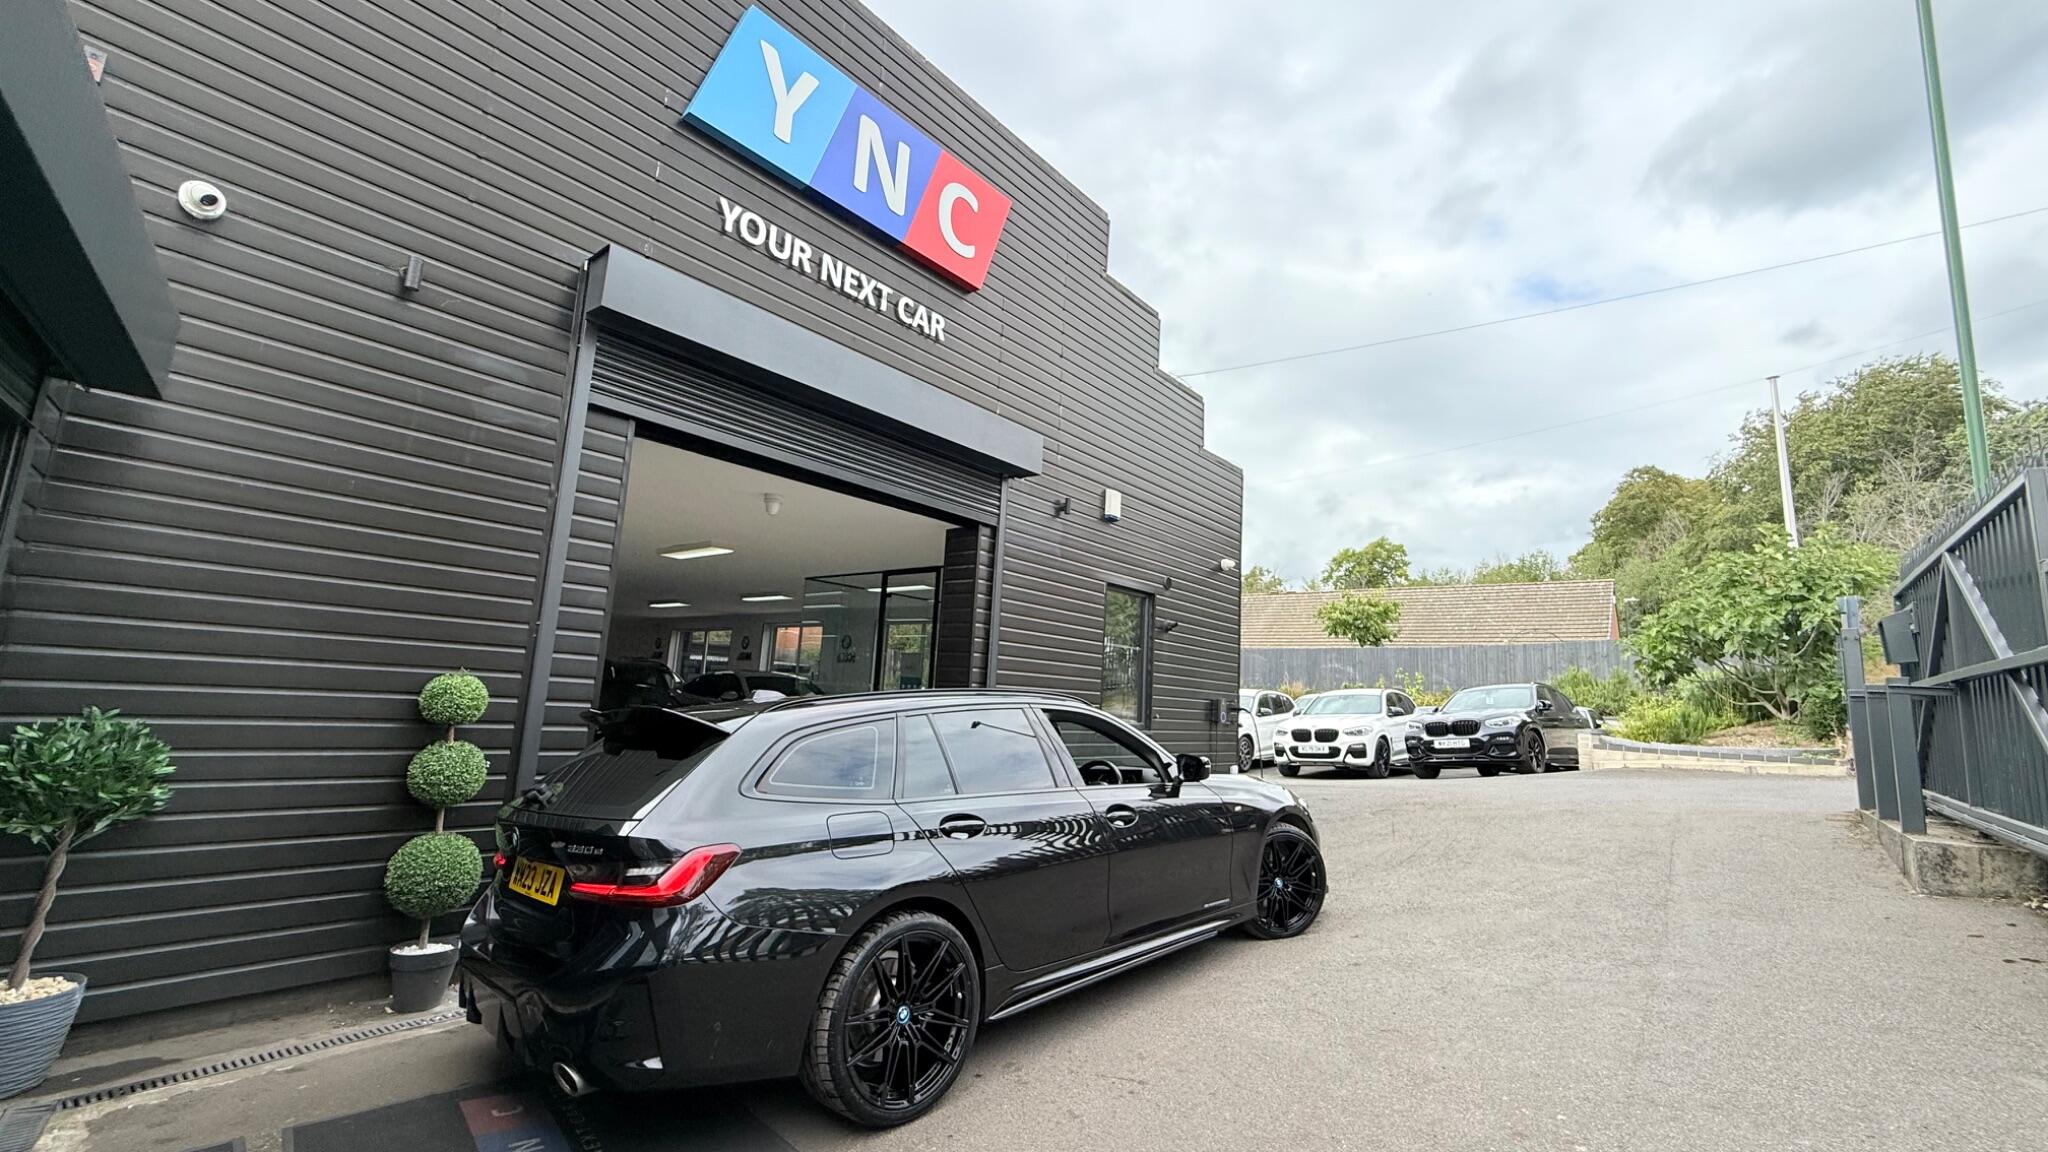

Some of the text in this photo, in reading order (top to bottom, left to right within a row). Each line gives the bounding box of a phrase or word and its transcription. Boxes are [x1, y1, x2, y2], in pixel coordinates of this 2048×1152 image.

[760, 39, 979, 259] YNC
[719, 196, 946, 341] YOUR NEXT CAR
